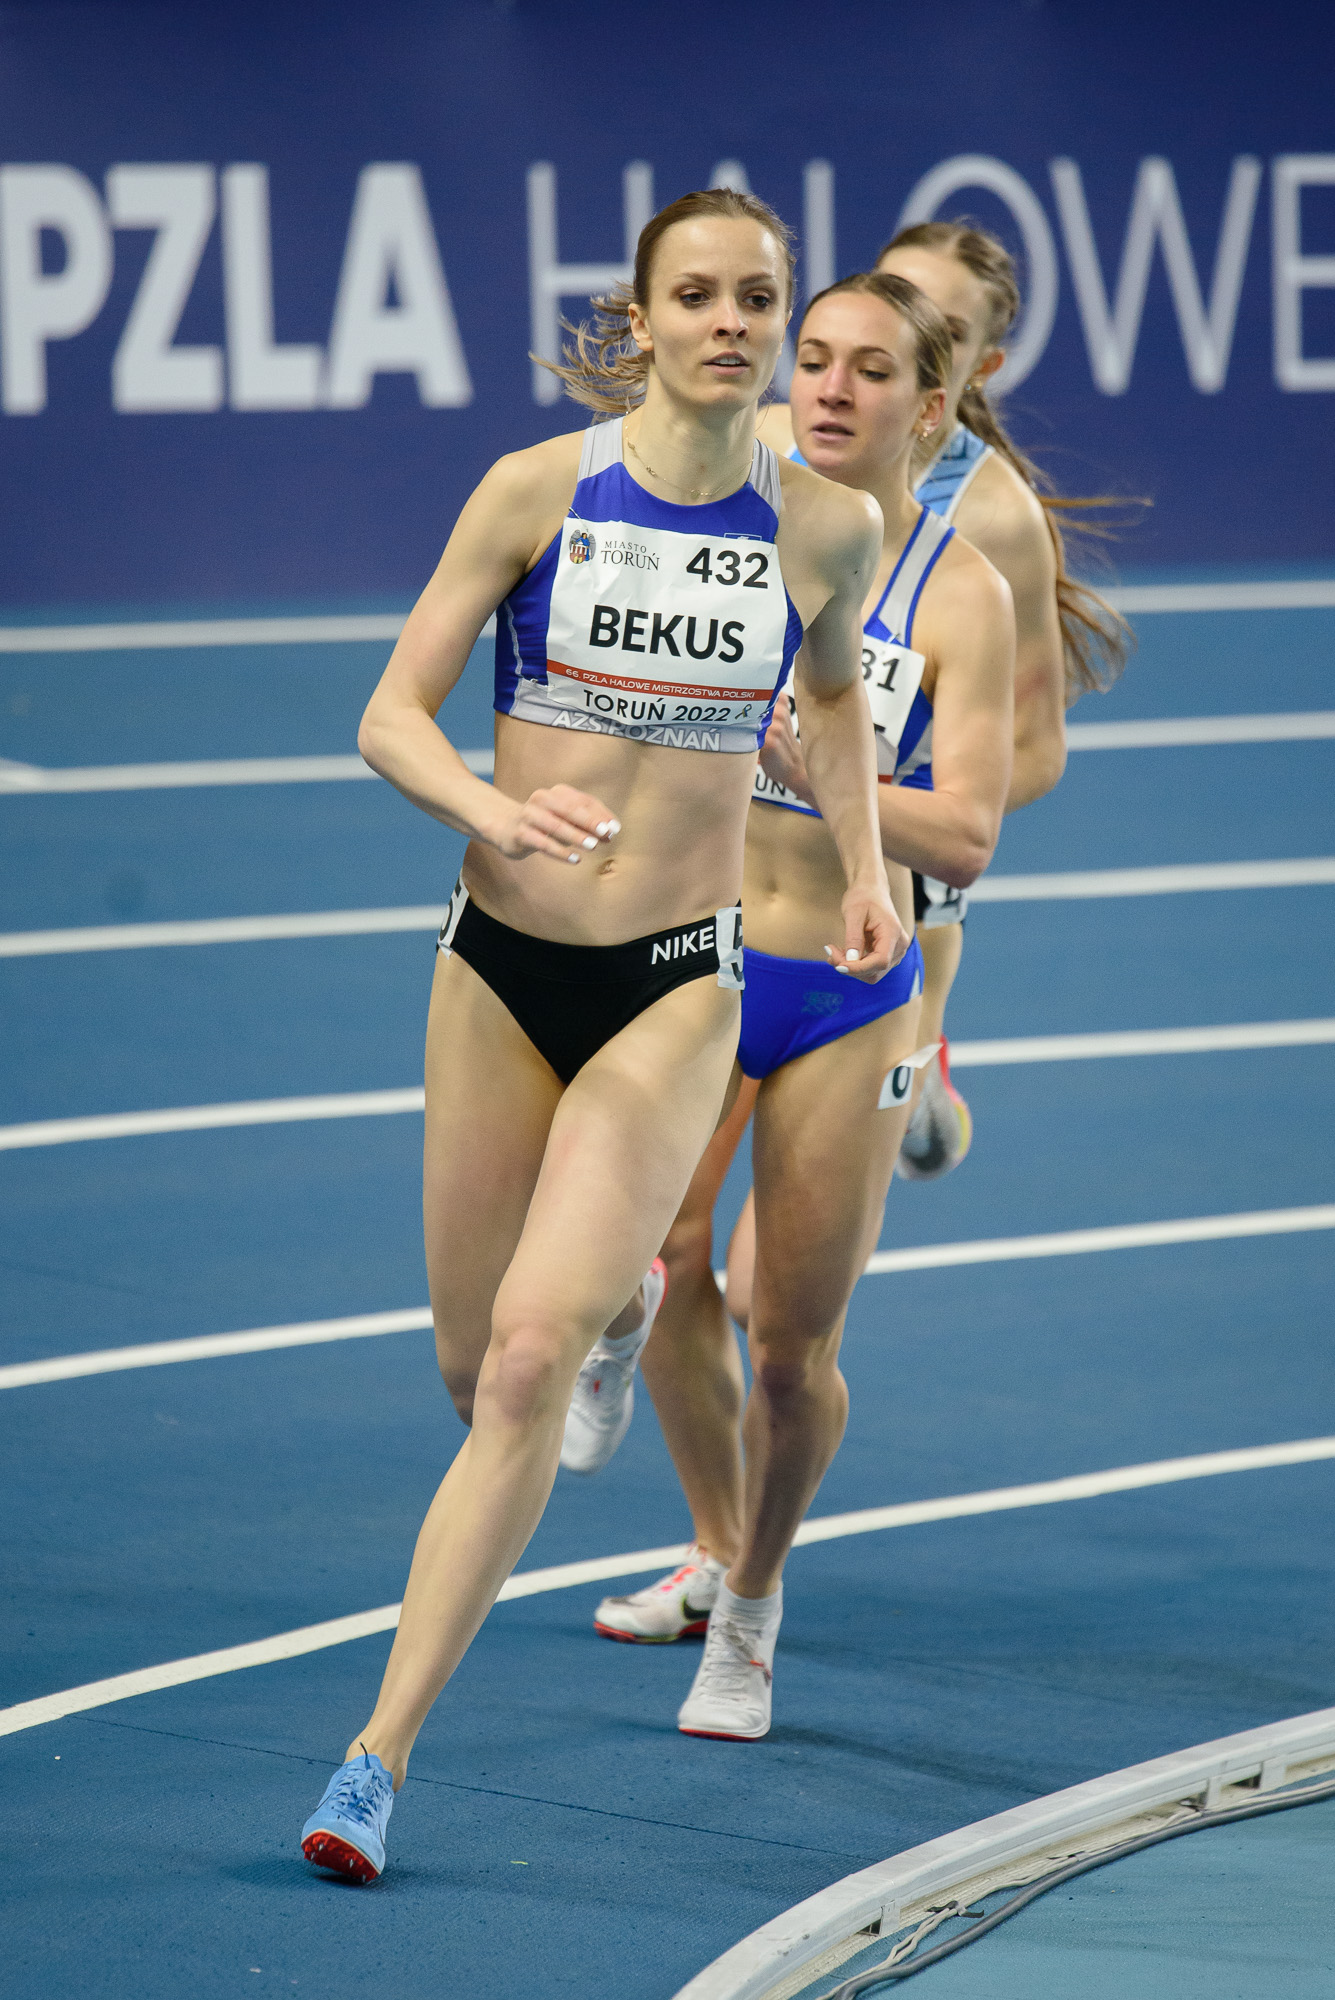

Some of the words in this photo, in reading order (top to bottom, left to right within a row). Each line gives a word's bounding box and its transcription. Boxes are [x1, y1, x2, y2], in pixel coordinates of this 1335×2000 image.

[0, 163, 472, 415] PZLA
[525, 153, 1335, 406] HOWE
[601, 550, 660, 571] TORUŃ
[605, 541, 647, 553] MIASTO
[686, 547, 769, 589] 432
[589, 604, 746, 663] BEKUS
[582, 672, 608, 685] PZLA
[609, 678, 650, 692] HALOWE
[651, 684, 721, 698] MISTRZOSTWA
[722, 690, 756, 699] POLSKI
[551, 710, 602, 734] AZS
[583, 689, 667, 721] TORUŃ
[671, 704, 732, 722] 2022
[651, 925, 715, 965] NIKE
